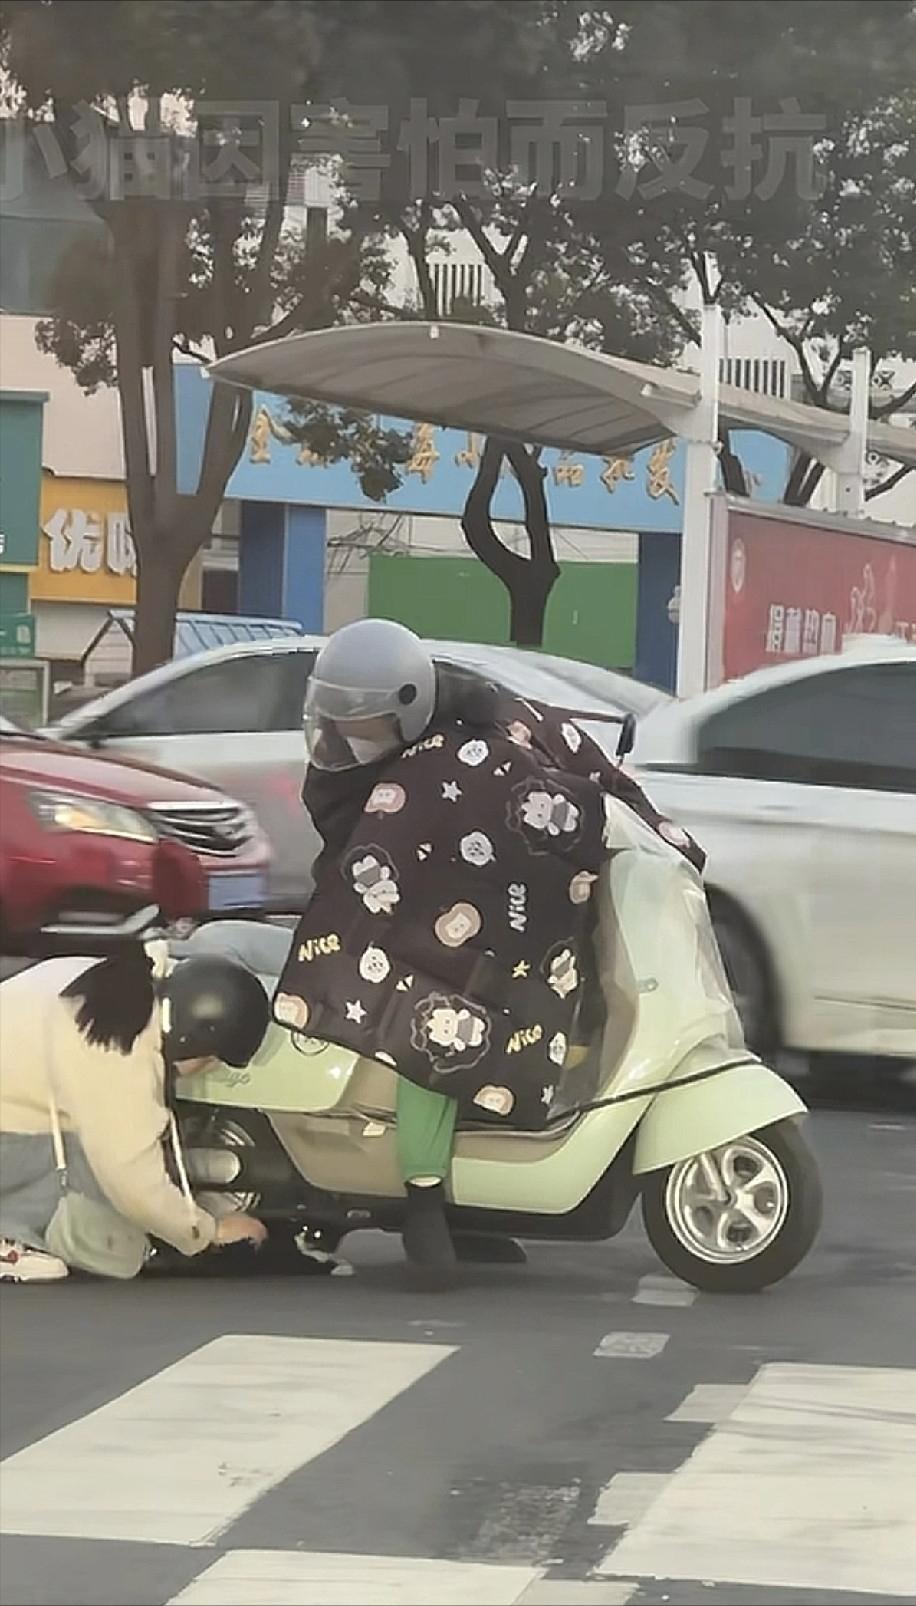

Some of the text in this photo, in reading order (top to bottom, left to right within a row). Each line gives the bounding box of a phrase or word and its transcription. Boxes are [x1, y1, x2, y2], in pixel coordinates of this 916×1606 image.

[507, 883, 528, 933] Nice
[298, 933, 341, 962] Nice
[505, 1024, 543, 1055] Nice
